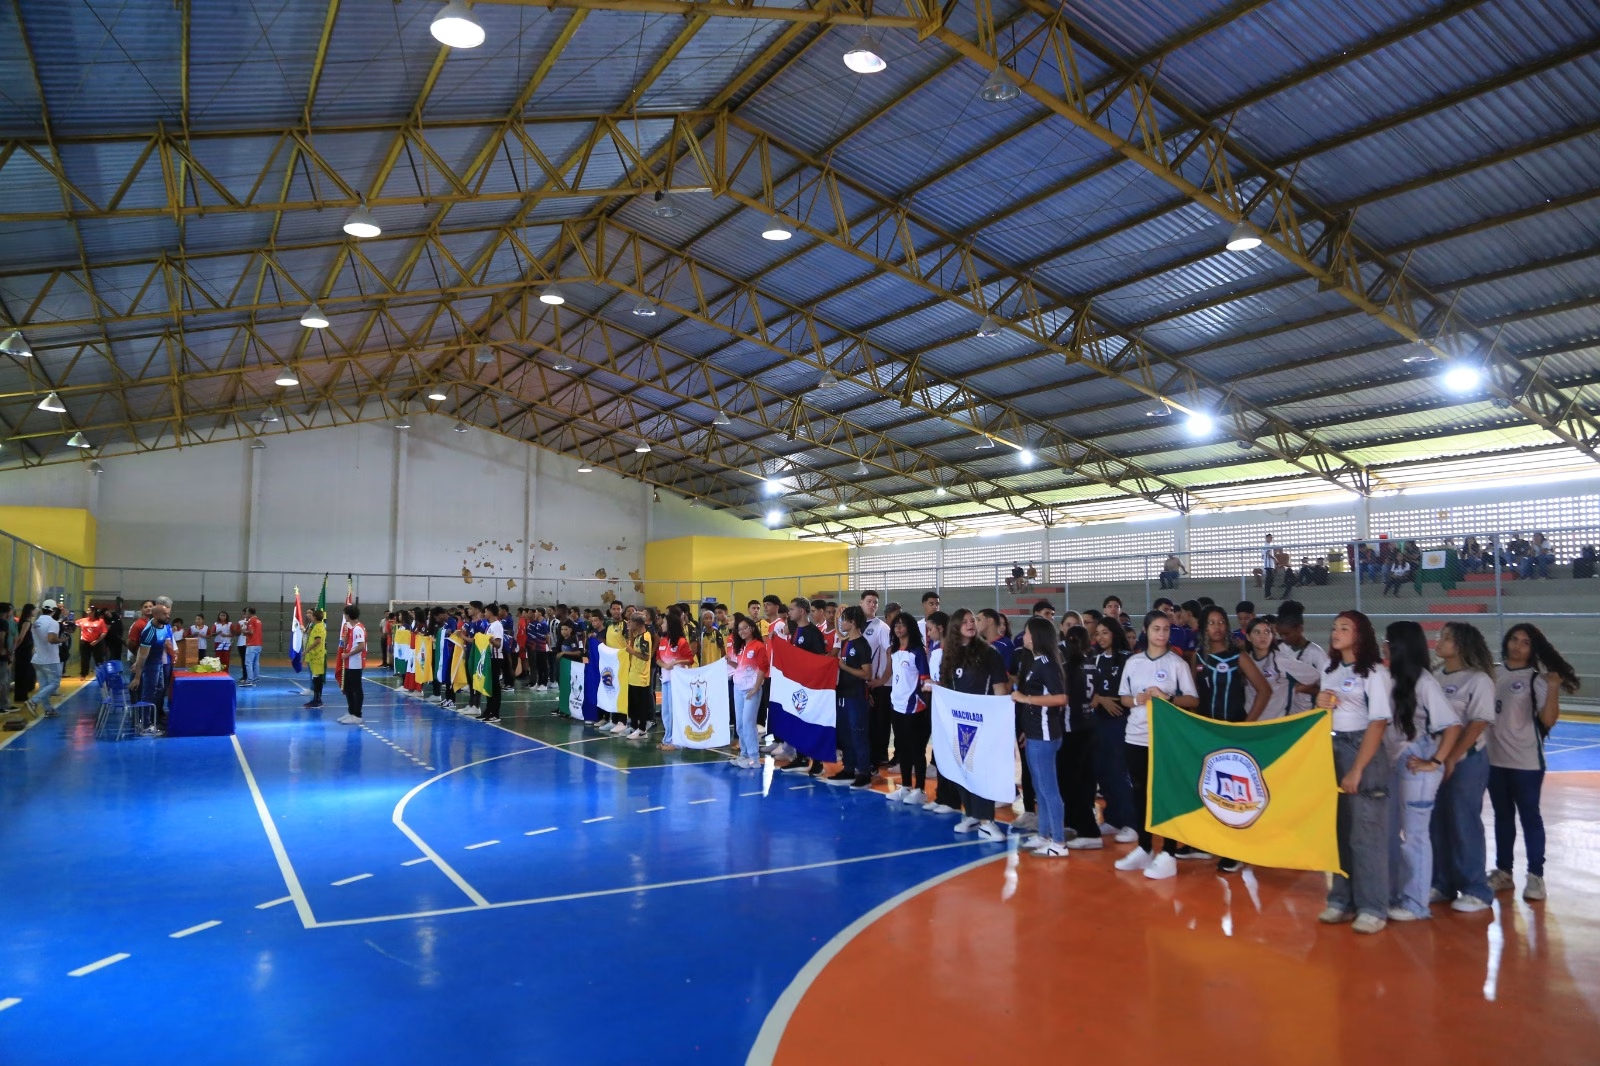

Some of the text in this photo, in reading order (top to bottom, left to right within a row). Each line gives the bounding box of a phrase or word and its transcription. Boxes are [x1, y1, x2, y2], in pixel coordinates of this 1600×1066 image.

[955, 667, 963, 679] 9
[1086, 674, 1095, 699] 5
[1103, 680, 1109, 690] 2
[951, 709, 984, 723] IMACULADA
